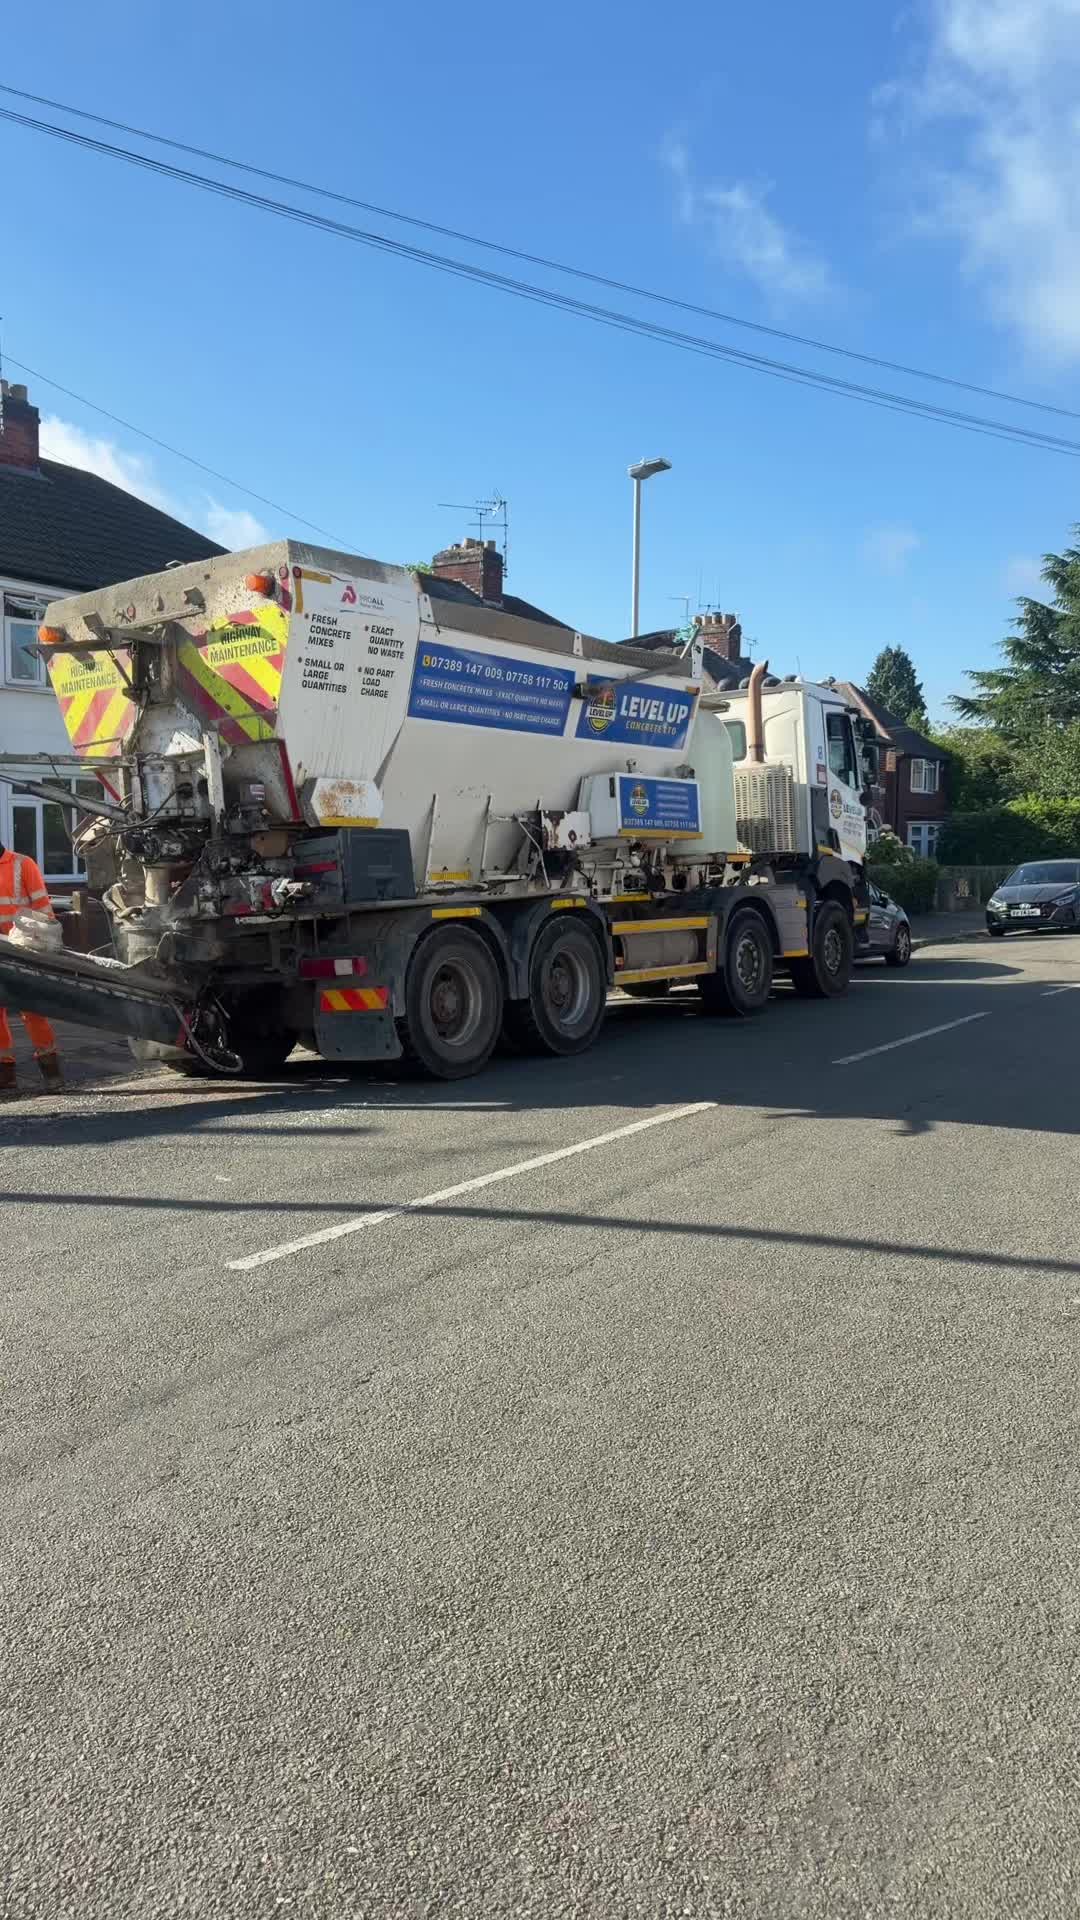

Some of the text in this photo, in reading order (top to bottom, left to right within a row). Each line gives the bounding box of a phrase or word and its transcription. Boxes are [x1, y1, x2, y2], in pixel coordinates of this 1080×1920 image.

[312, 613, 338, 626] FRESH
[221, 624, 261, 645] HIGHWAY
[309, 625, 351, 640] CONCRETE
[371, 625, 394, 637] EXACT
[308, 636, 335, 648] MIXES
[369, 636, 404, 649] QUANTITY
[210, 638, 278, 664] MAINTENANCE
[368, 646, 405, 660] NO WASTE
[70, 660, 104, 678] HIGHWAY
[304, 658, 345, 672] SMALL OR
[303, 669, 329, 680] LARGE
[363, 666, 395, 679] NO PART
[431, 656, 462, 672] 07389
[465, 663, 483, 677] 147
[506, 671, 534, 685] 07758
[536, 676, 551, 688] 117
[553, 679, 569, 691] 504
[61, 673, 117, 694] MAINTENANCE
[301, 680, 347, 693] QUANTITIES
[362, 677, 381, 687] LOAD
[422, 678, 442, 689] FRESH
[443, 682, 473, 694] CONCRETE
[474, 687, 493, 697] MIXES
[360, 687, 389, 699] CHARGE
[420, 698, 439, 708] SMALL
[440, 701, 449, 710] OR
[504, 711, 513, 719] NO
[590, 708, 614, 718] LEVEL UP
[620, 695, 689, 725] LEVEL UP
[625, 720, 663, 734] CONCRETE
